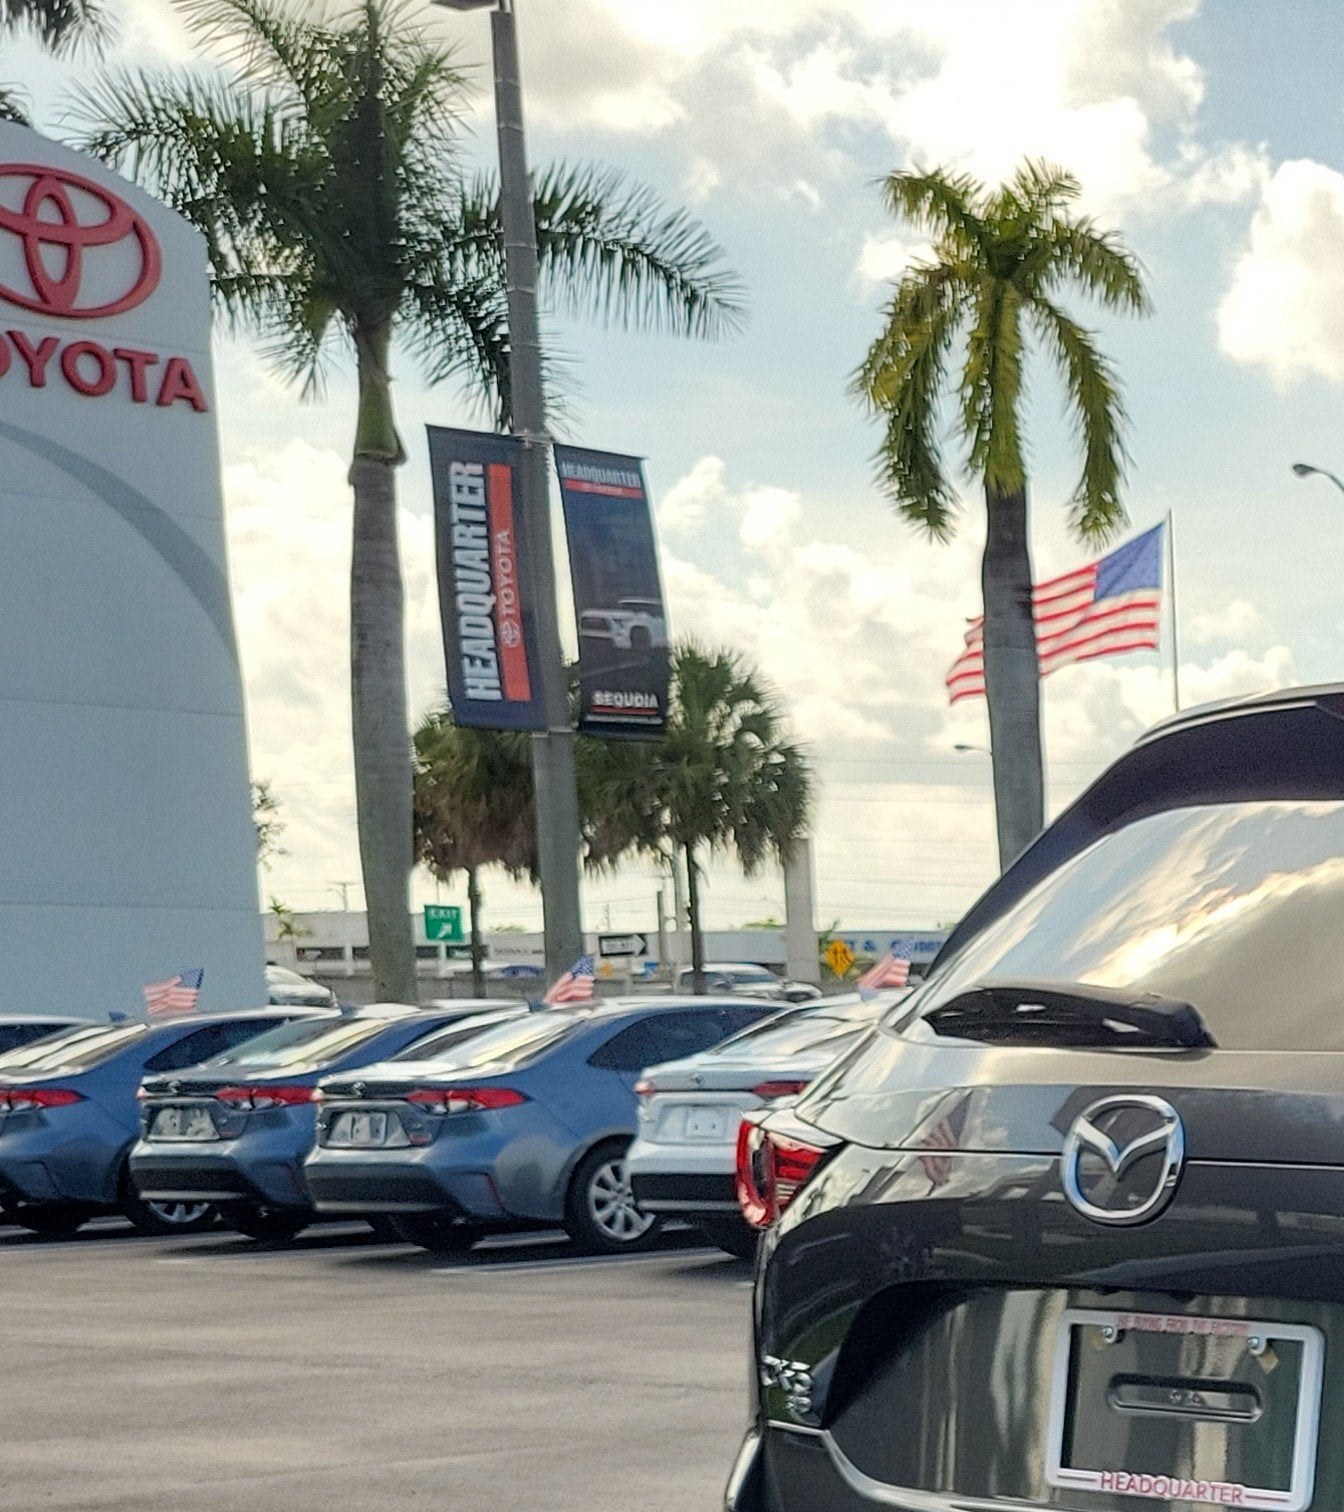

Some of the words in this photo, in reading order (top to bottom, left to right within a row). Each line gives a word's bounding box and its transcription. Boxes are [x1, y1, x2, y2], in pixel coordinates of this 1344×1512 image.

[0, 330, 209, 412] YOTA
[451, 461, 503, 700] HEADQUARTER
[494, 530, 520, 616] TOYOTA
[592, 690, 659, 708] SEQUOIA
[428, 908, 459, 920] EXIT
[1100, 1471, 1243, 1503] HEADQUARTER
